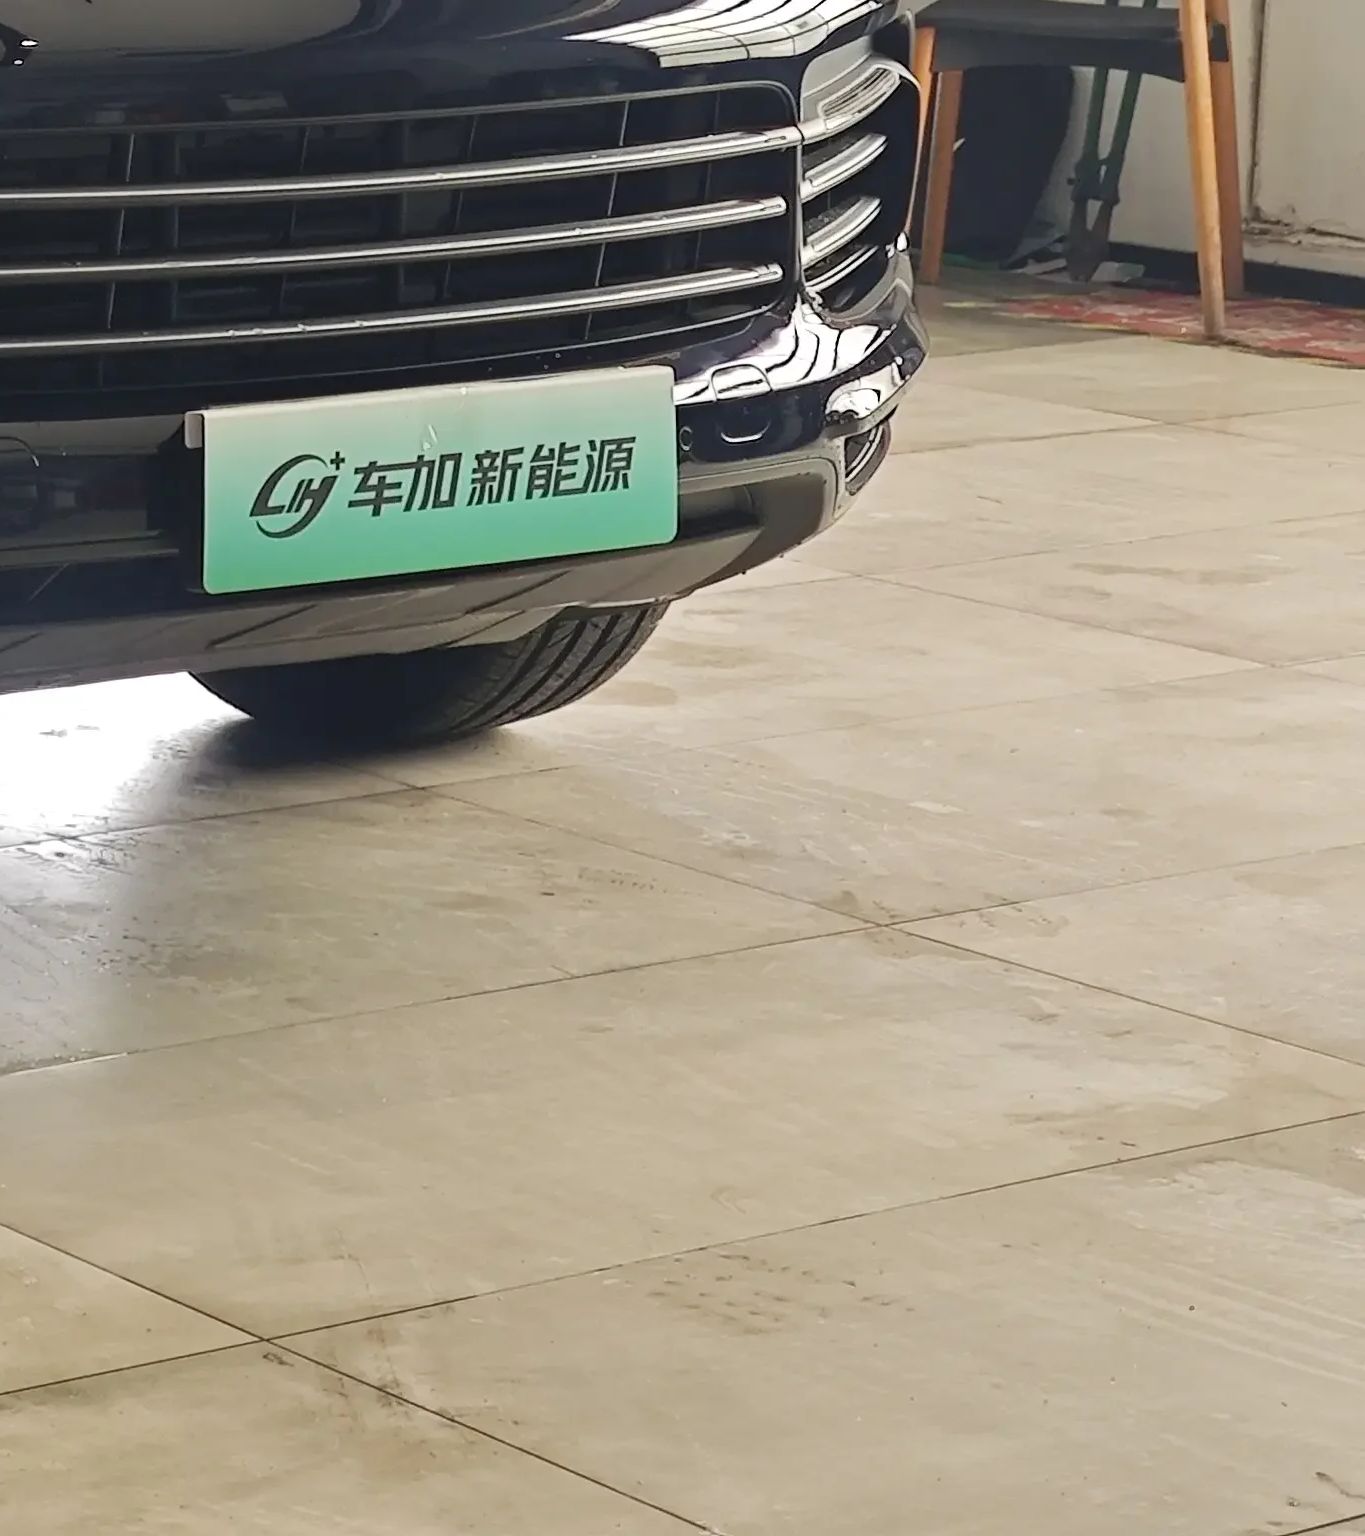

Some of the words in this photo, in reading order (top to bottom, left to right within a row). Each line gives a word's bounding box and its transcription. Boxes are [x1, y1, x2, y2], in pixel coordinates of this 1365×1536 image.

[347, 436, 637, 517] 车加新能源
